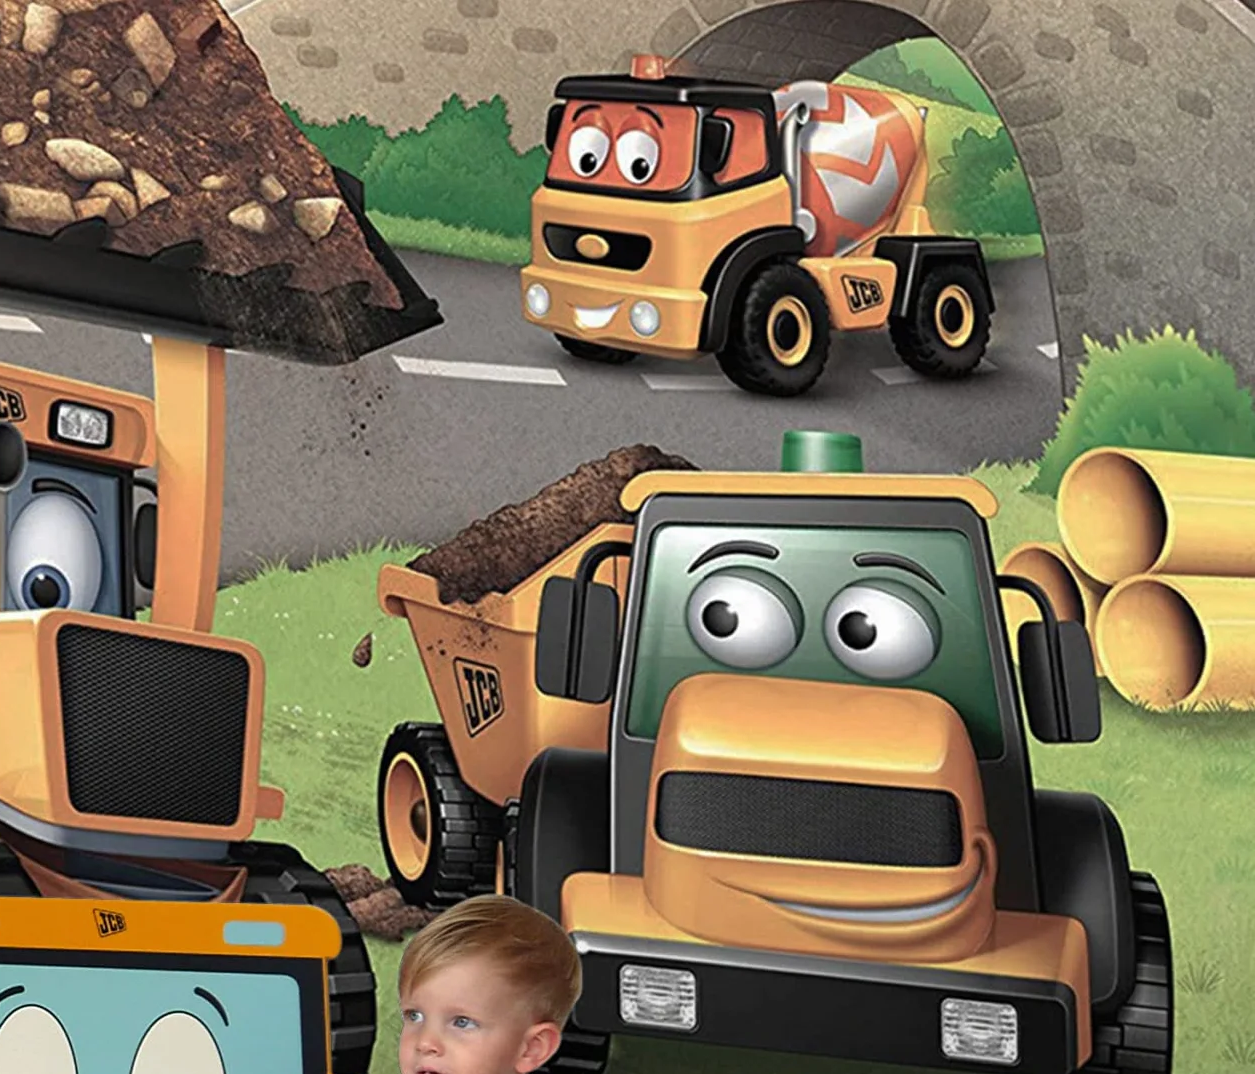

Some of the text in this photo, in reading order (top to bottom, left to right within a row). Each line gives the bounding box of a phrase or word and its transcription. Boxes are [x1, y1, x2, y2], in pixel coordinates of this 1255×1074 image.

[849, 280, 881, 308] JCB
[463, 666, 500, 729] JCB
[99, 912, 124, 934] JCB
